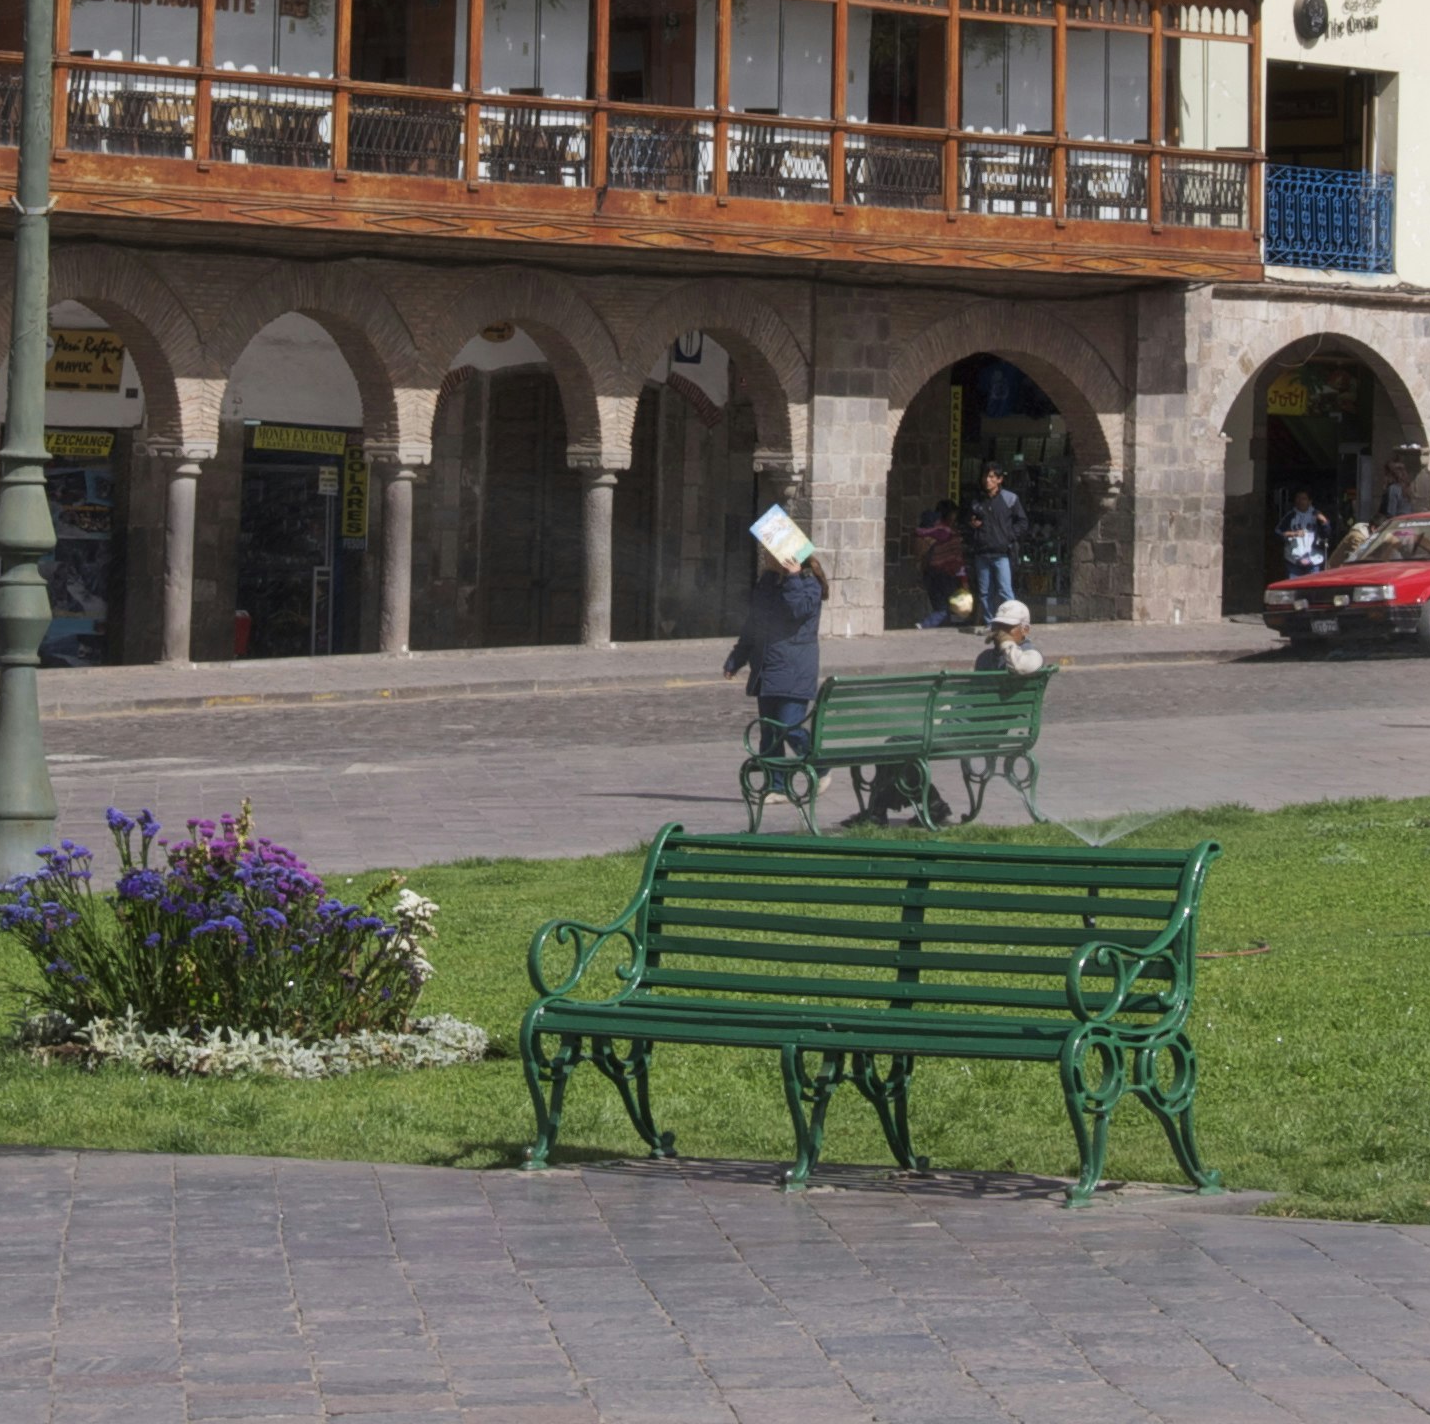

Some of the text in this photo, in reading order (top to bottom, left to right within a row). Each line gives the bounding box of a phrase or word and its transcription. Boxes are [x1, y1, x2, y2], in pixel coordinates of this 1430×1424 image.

[54, 360, 92, 373] MAYUC
[952, 391, 960, 433] CALL
[55, 434, 112, 448] EXCHANGE
[258, 427, 344, 446] MONEY EXCHANGE
[347, 446, 366, 534] DOLARES
